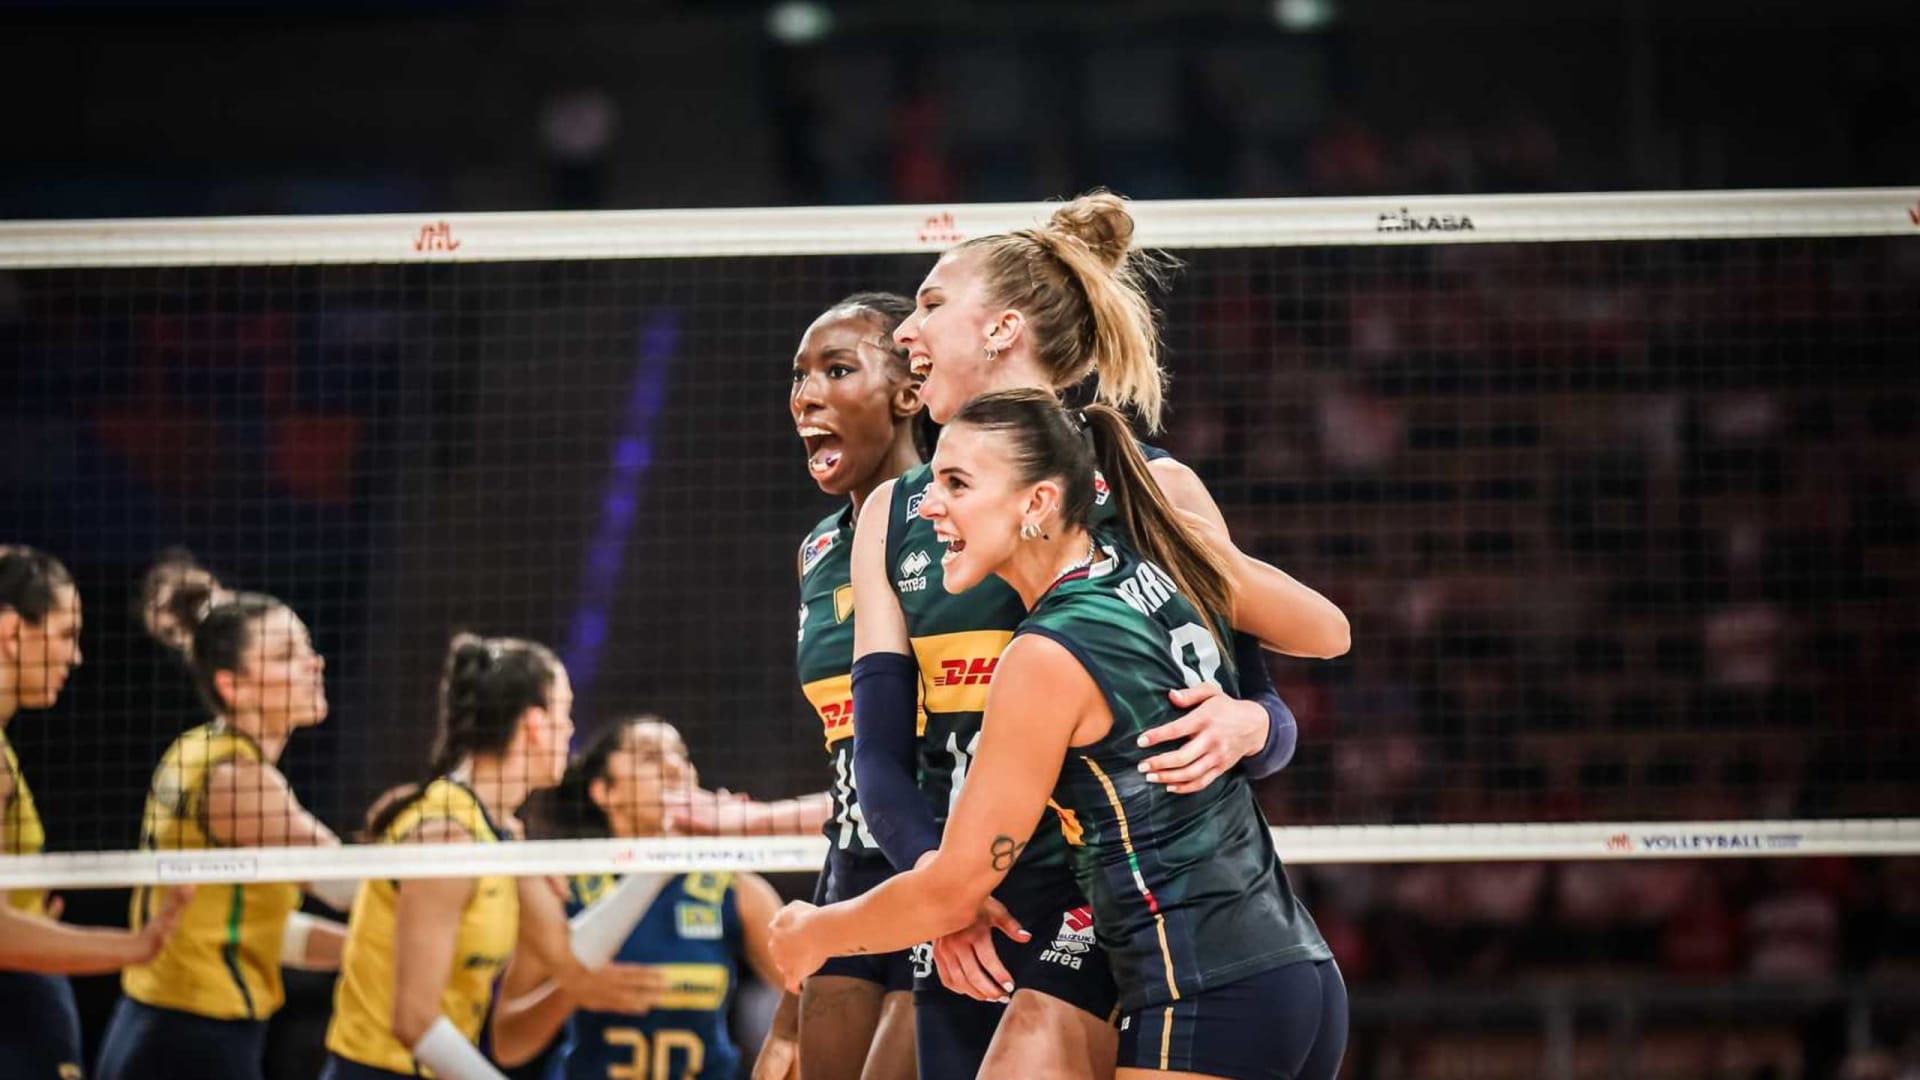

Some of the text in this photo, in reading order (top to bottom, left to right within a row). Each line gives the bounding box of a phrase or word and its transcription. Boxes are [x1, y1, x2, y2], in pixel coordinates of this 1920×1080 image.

[940, 658, 1000, 686] DH
[820, 699, 854, 729] DH
[1642, 834, 1760, 849] VOLLEYBALL
